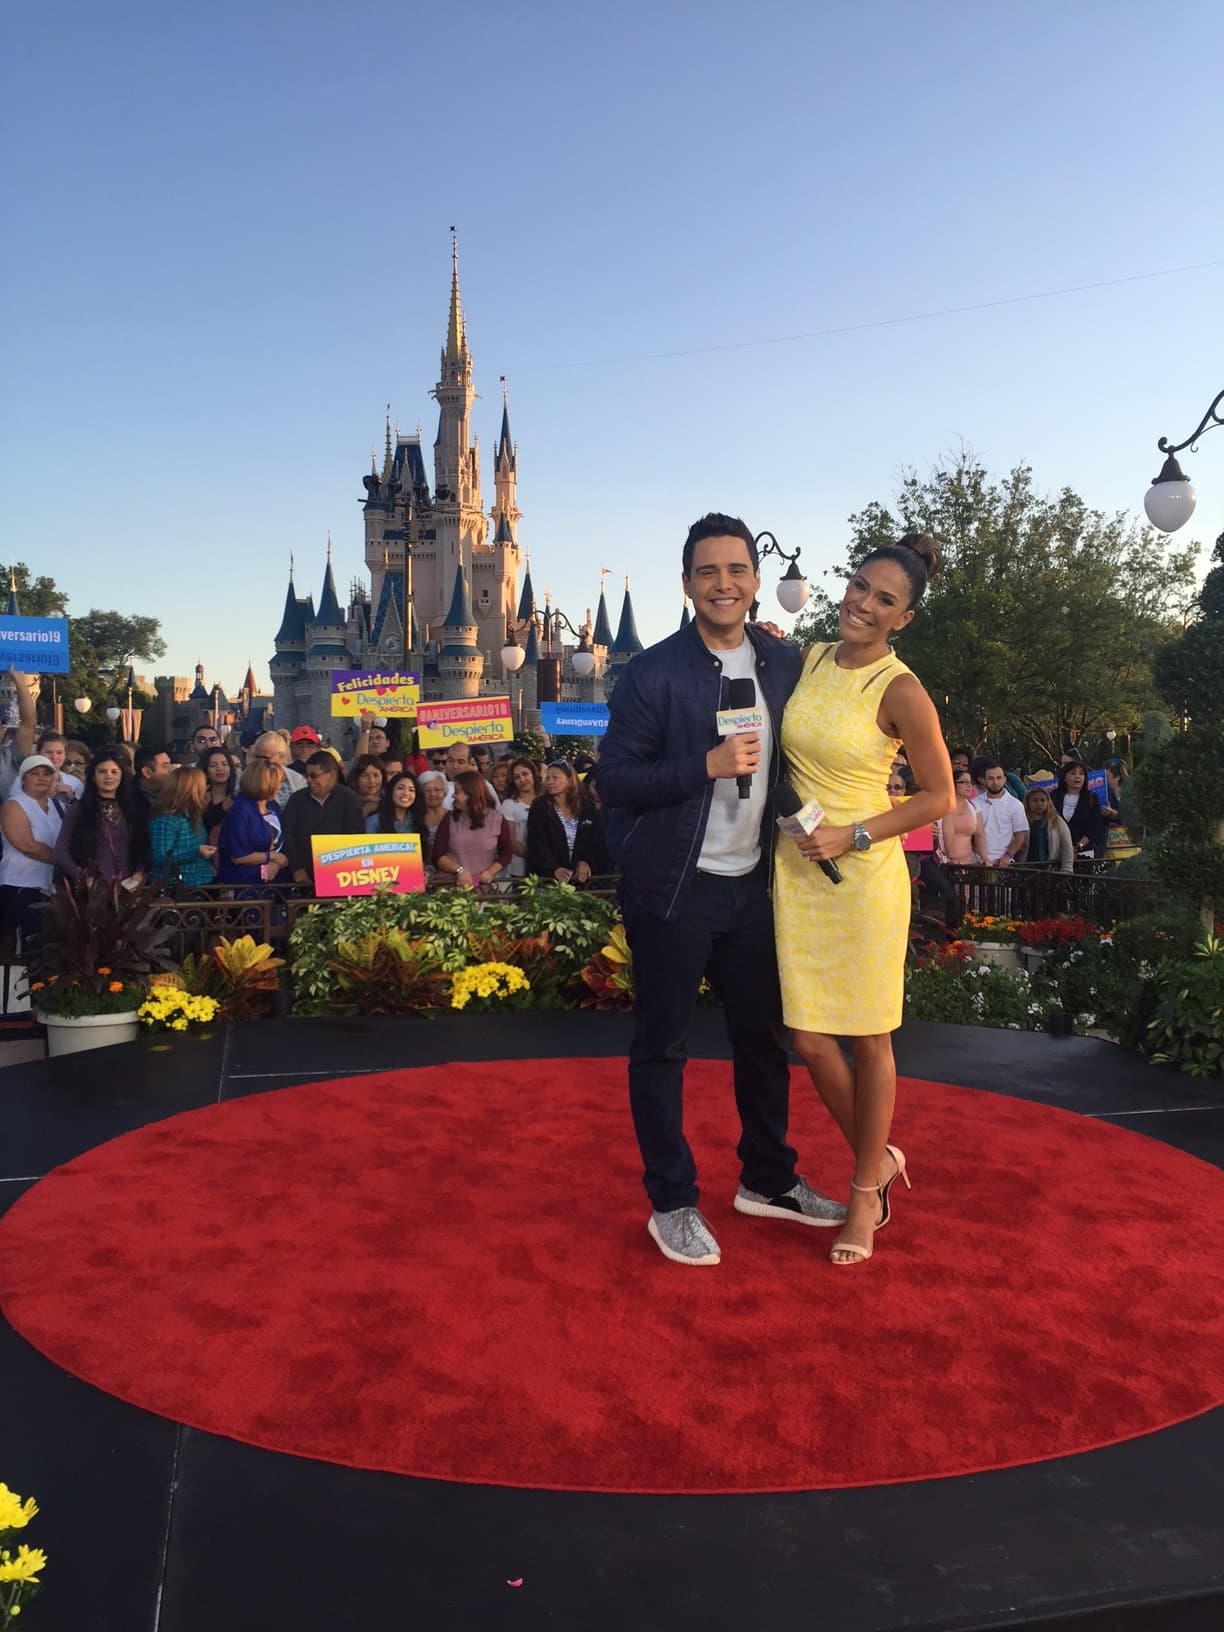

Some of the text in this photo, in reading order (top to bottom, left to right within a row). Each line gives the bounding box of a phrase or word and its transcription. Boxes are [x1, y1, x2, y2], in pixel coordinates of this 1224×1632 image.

[0, 630, 61, 643] versario19
[337, 672, 415, 692] Felicidades
[357, 693, 414, 707] Despierta
[718, 712, 762, 726] Despierta
[442, 721, 504, 738] Despierta
[320, 845, 370, 865] DESPIERTA
[336, 865, 400, 888] DISNEY
